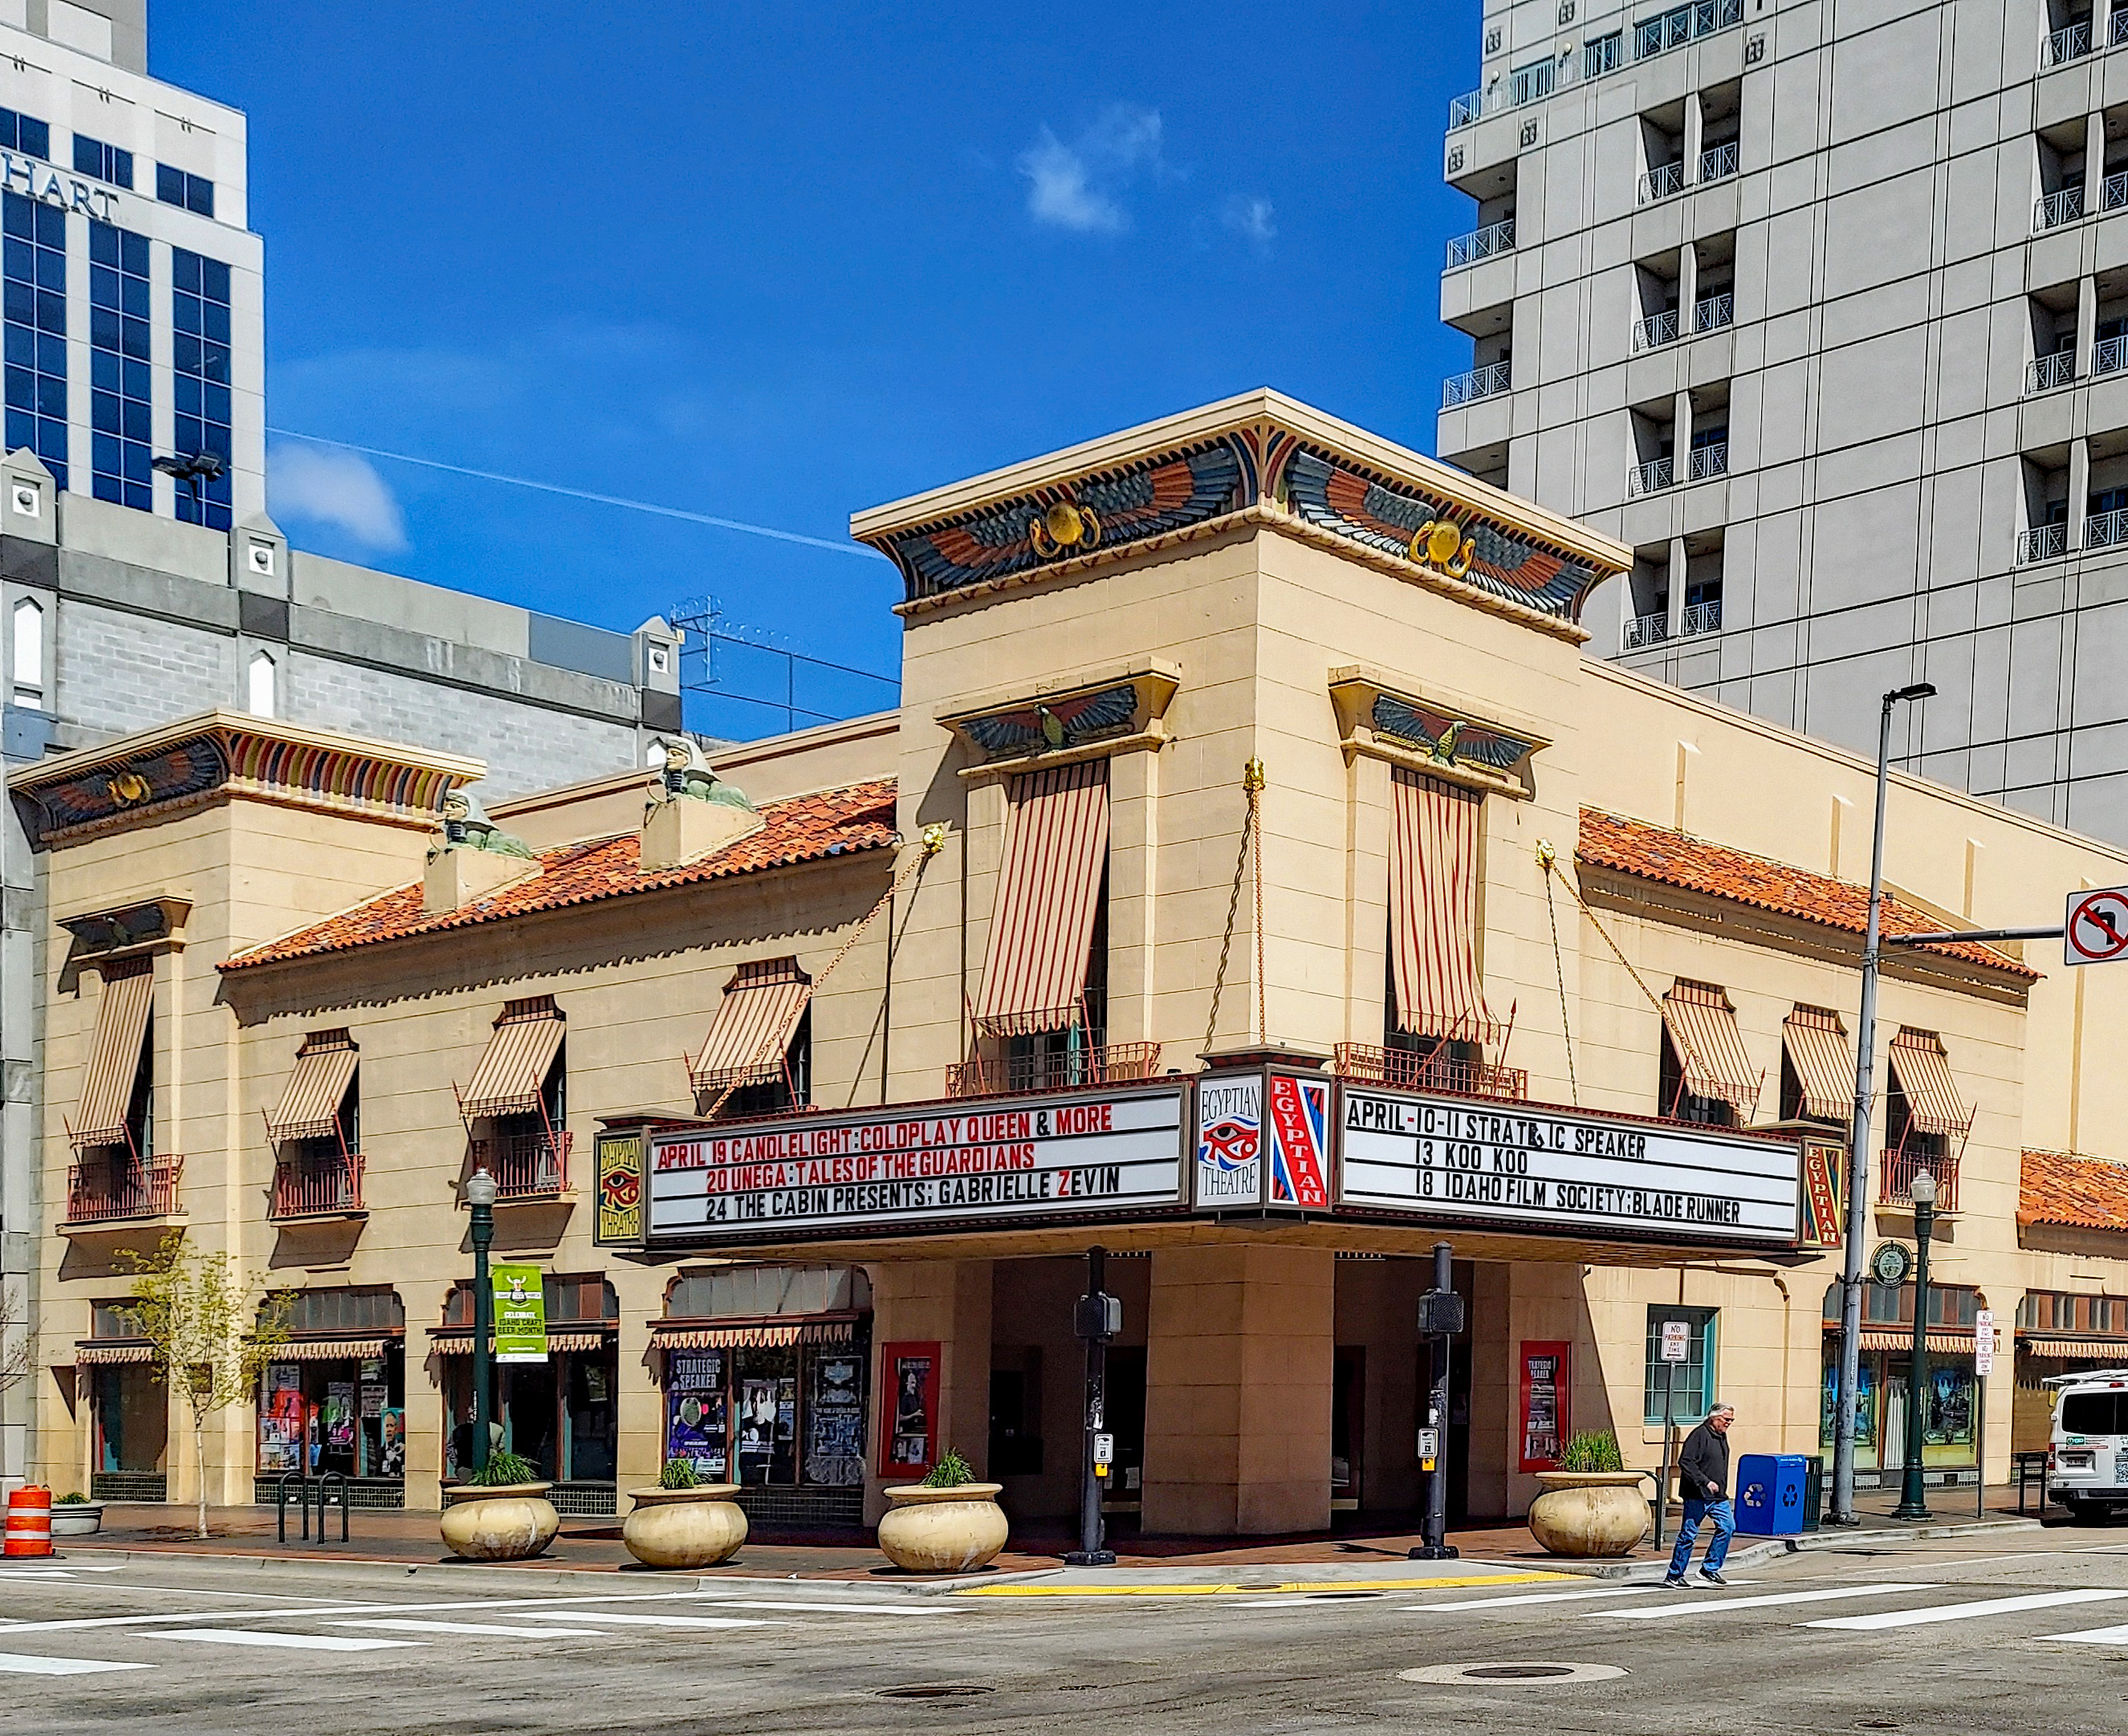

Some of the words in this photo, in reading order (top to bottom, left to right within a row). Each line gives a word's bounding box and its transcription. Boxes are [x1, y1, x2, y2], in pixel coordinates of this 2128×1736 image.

[0, 151, 120, 222] HART
[1201, 1086, 1260, 1124] EGYPTIAN
[657, 1144, 706, 1169] APRIL
[712, 1140, 726, 1164] 19
[861, 1119, 961, 1151] COLDPLAY
[966, 1113, 1030, 1142] QUEEN
[1036, 1111, 1051, 1136] &
[1056, 1104, 1113, 1134] MORE
[1273, 1080, 1322, 1203] EGYPTIAN
[1416, 1140, 1433, 1165] 13
[1446, 1143, 1481, 1169] KOO
[1494, 1148, 1528, 1174] KOO
[1575, 1127, 1646, 1159] SPEAKER
[706, 1169, 727, 1193] 20
[795, 1157, 852, 1185] TALES
[856, 1155, 878, 1181] OF
[882, 1153, 916, 1178] THE
[920, 1144, 1035, 1176] GUARDIANS
[1203, 1162, 1256, 1196] THEATRE
[706, 1198, 726, 1222] 24
[734, 1193, 765, 1218] THE
[772, 1189, 828, 1216] CABIN
[939, 1173, 1050, 1205] GABRIELLE
[1058, 1166, 1120, 1196] ZEVIN
[1416, 1169, 1434, 1196] 18
[1446, 1172, 1501, 1201] IDAHO
[1506, 1178, 1546, 1206] FILM
[1633, 1192, 1682, 1218] BLADE
[1687, 1197, 1740, 1223] RUNNER
[1808, 1147, 1837, 1242] EGYPTIAN
[676, 1359, 721, 1374] STRATEGIC
[680, 1373, 717, 1389] SPEAKER
